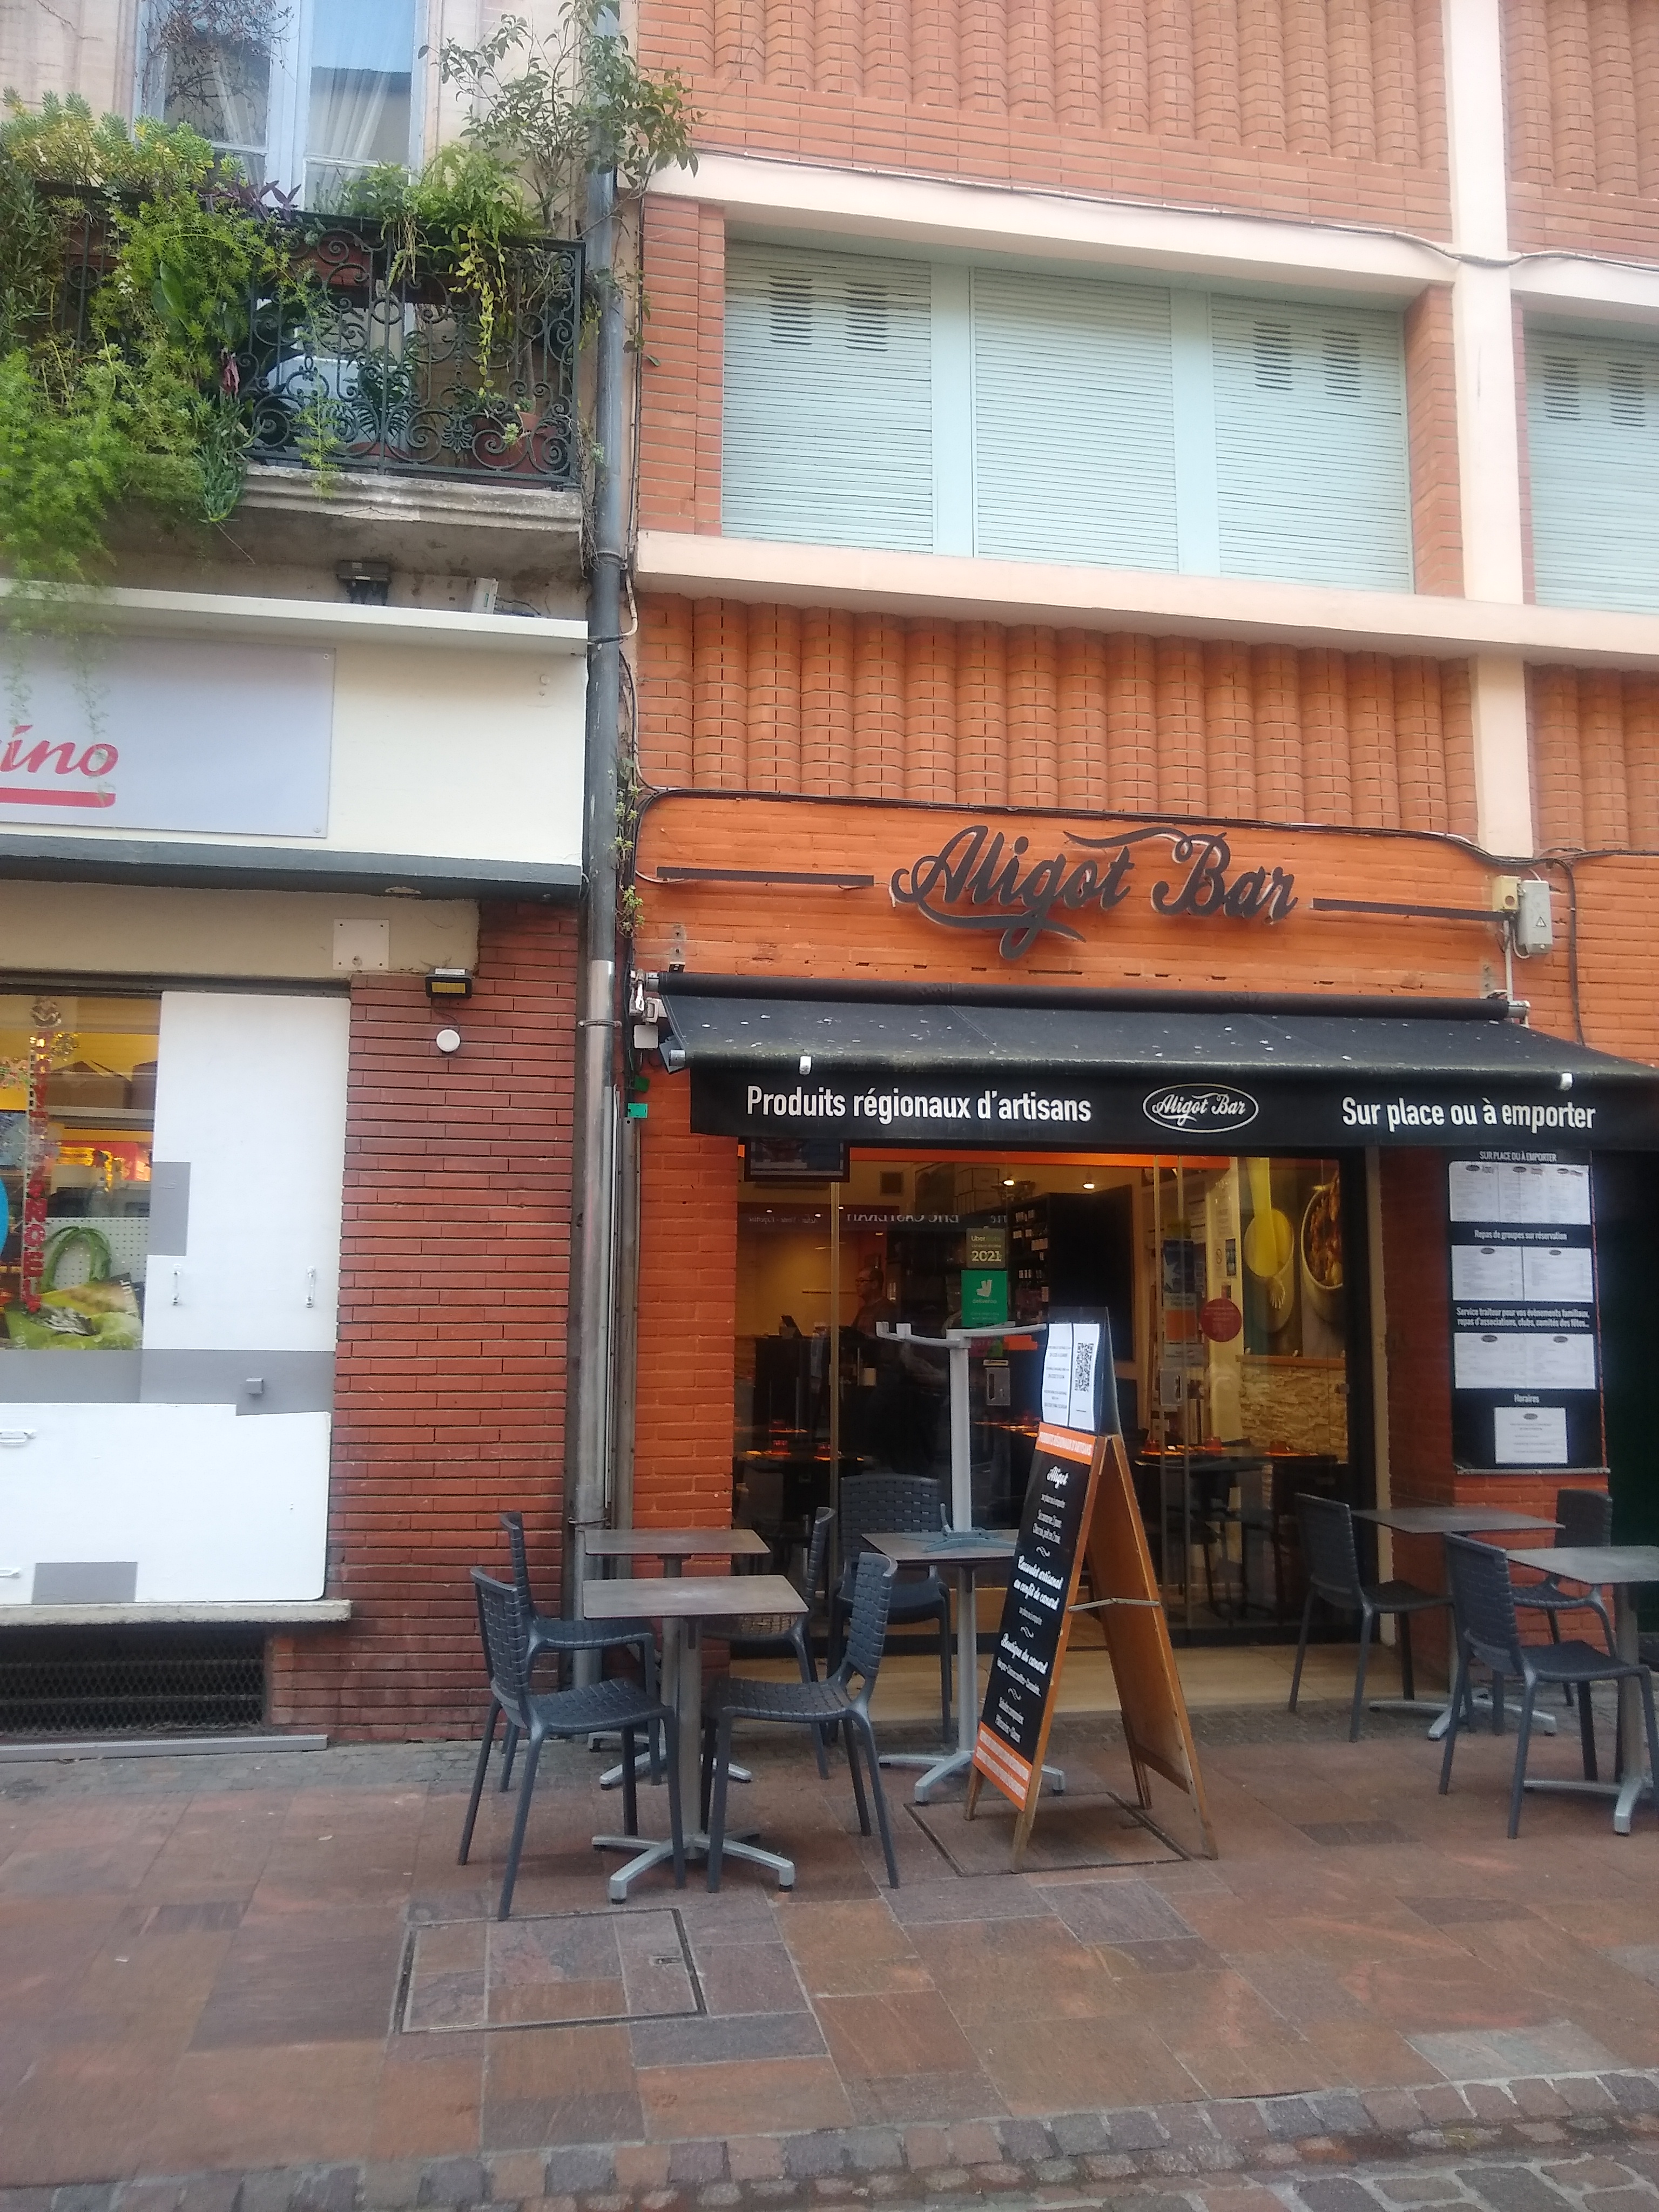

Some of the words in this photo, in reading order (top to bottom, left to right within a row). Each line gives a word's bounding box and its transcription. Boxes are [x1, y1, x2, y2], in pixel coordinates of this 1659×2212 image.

[0, 725, 119, 777] ino
[891, 825, 1135, 960] Aligot
[1063, 827, 1298, 924] Bar
[748, 1086, 846, 1116] Produits
[853, 1088, 971, 1124] régionaux
[977, 1090, 1091, 1122] d'artisans
[1152, 1094, 1209, 1126] Aligot
[1192, 1092, 1245, 1115] Bar
[1343, 1097, 1380, 1125] Sur
[1386, 1097, 1445, 1132] place
[1450, 1105, 1478, 1125] ou
[1482, 1097, 1497, 1125] à
[1502, 1102, 1596, 1134] emporter
[1480, 1151, 1493, 1159] SUR
[1493, 1151, 1510, 1161] PLACE
[1511, 1152, 1521, 1161] OU
[1521, 1150, 1526, 1161] À
[1474, 1229, 1493, 1239] Repas
[1493, 1230, 1500, 1239] de
[972, 1250, 1002, 1262] 2021
[1047, 1466, 1069, 1489] Aligot
